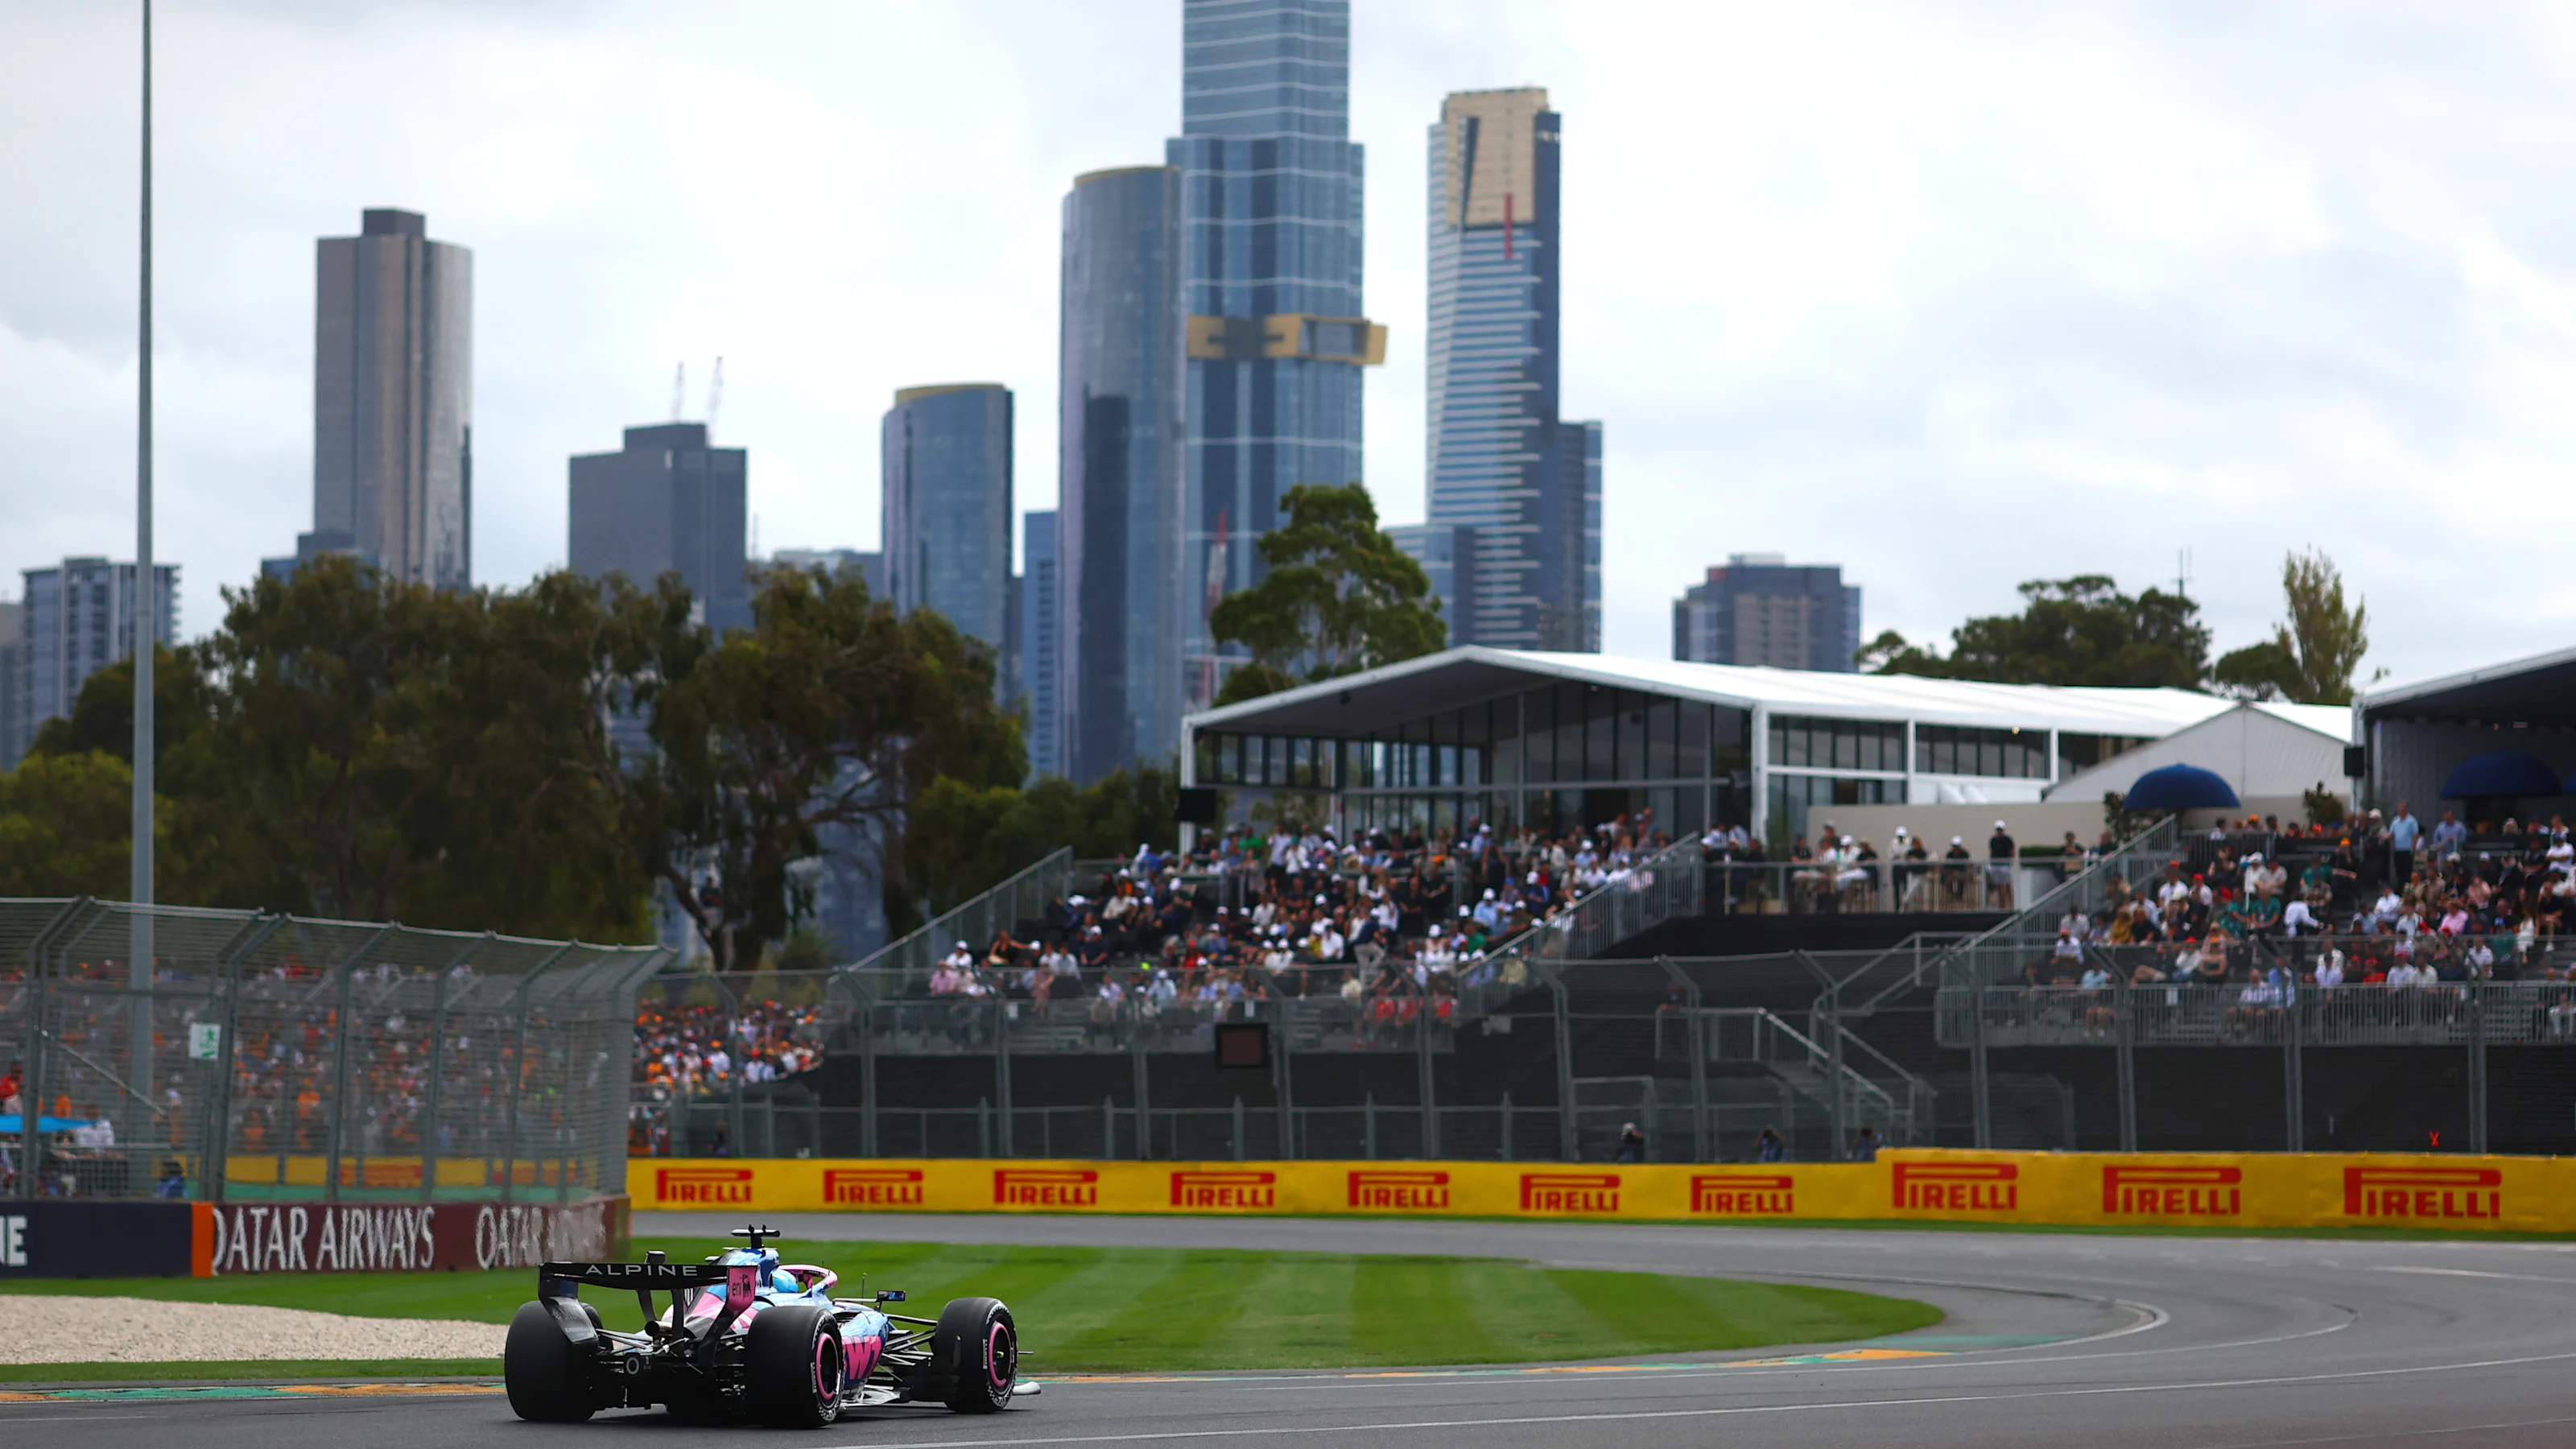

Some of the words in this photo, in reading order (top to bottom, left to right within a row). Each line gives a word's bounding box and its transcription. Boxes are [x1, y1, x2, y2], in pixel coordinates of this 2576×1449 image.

[658, 1170, 752, 1203] PIRELLI
[824, 1170, 923, 1204] PIRELLI
[995, 1170, 1097, 1206] PIRELLI
[1171, 1172, 1275, 1208] PIRELLI
[1349, 1171, 1449, 1208] PIRELLI
[1521, 1174, 1620, 1212] PIRELLI
[1692, 1175, 1793, 1212] PIRELLI
[1893, 1162, 2017, 1210] PIRELLI
[2103, 1166, 2241, 1215] PIRELLI
[2345, 1166, 2501, 1218] PIRELLI
[316, 1206, 435, 1269] AIRWAYS
[585, 1264, 698, 1277] ALPINE
[732, 1282, 741, 1297] eni
